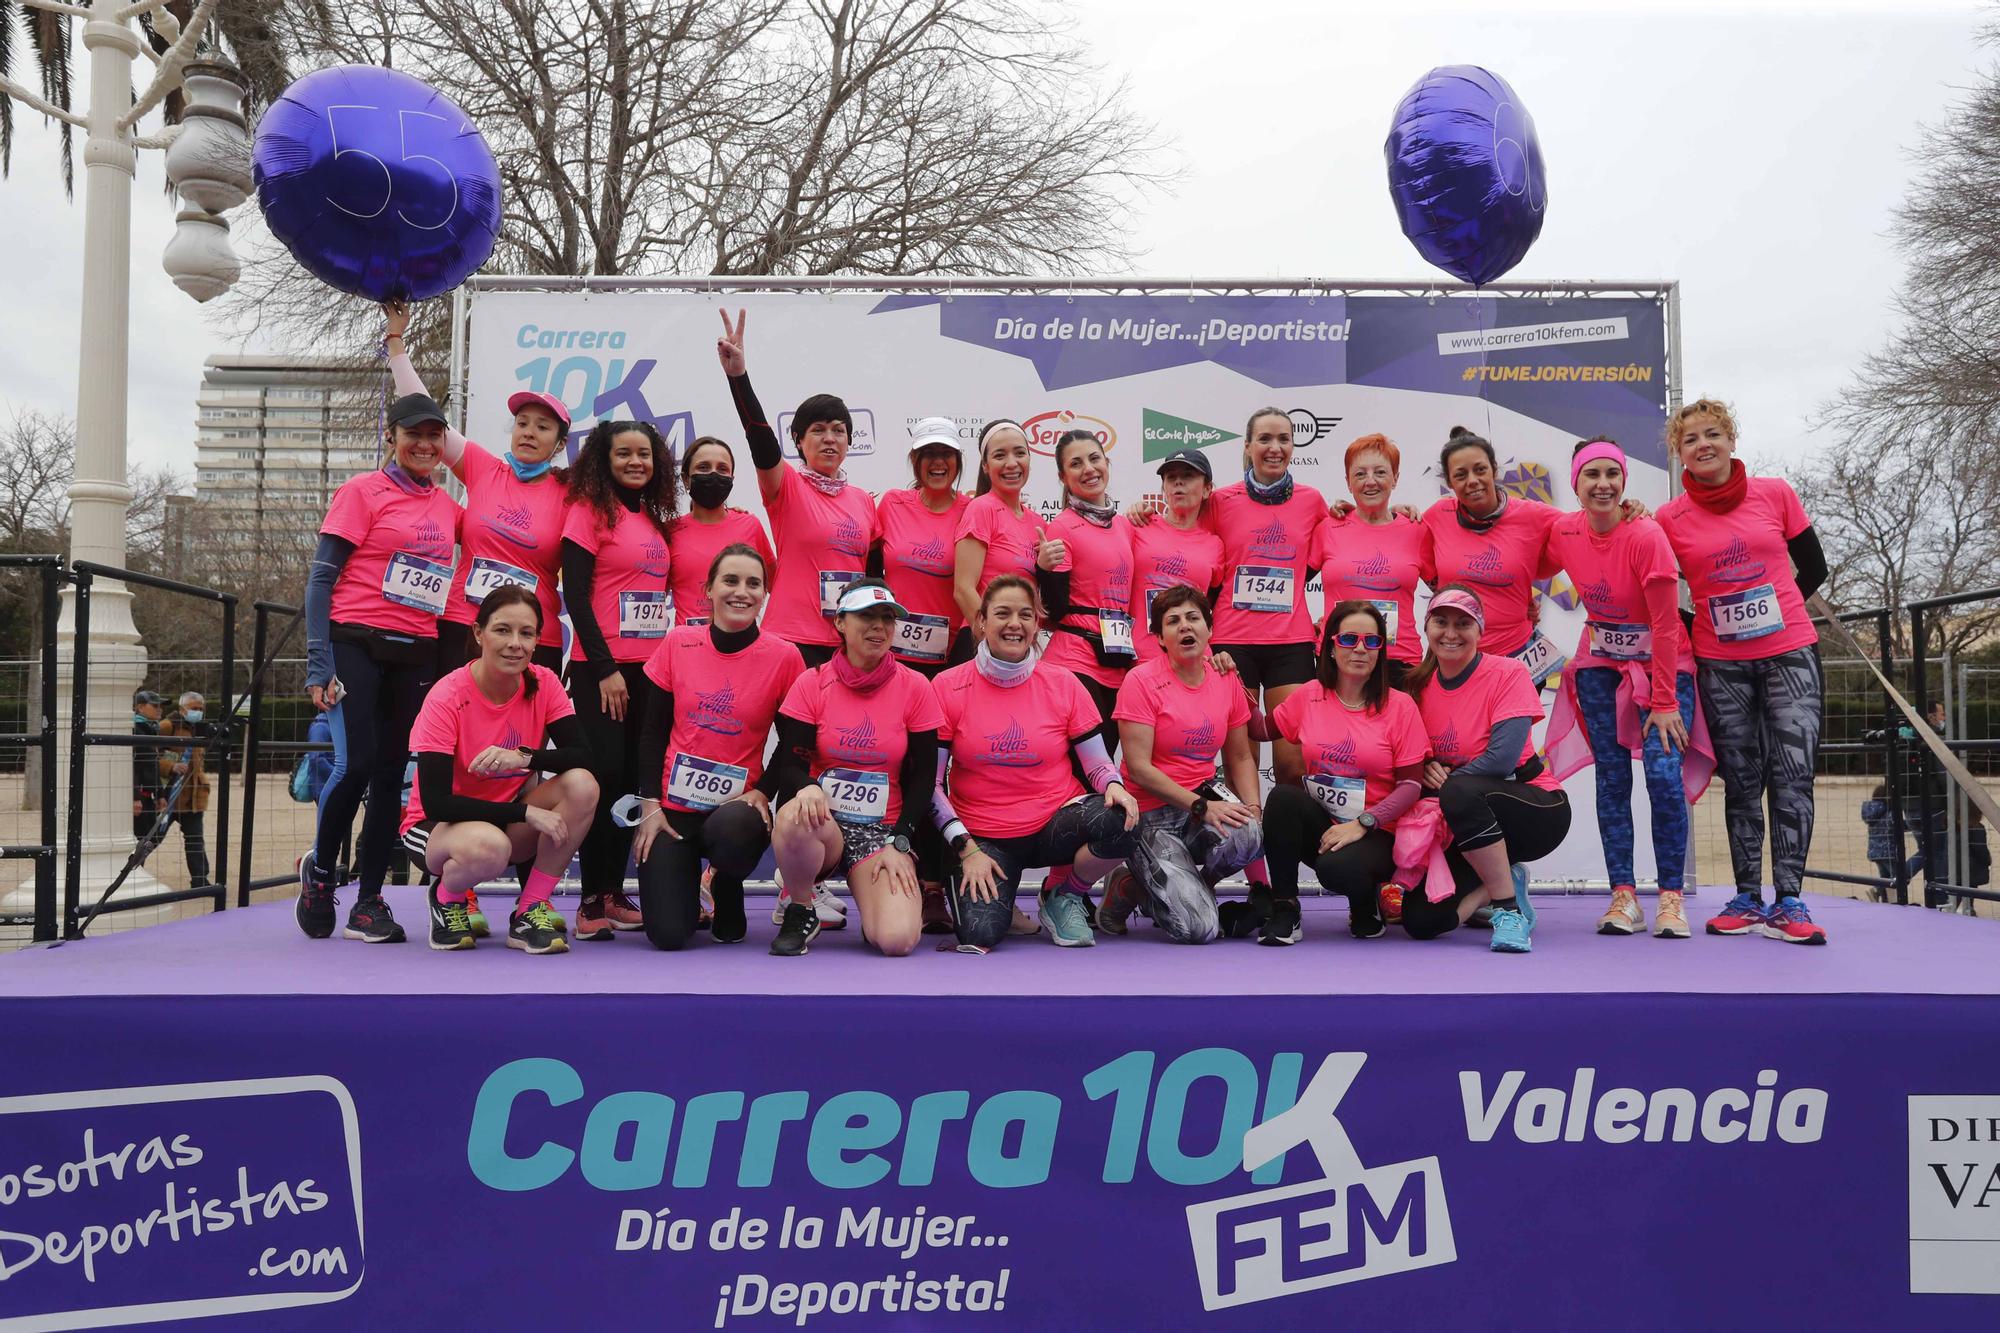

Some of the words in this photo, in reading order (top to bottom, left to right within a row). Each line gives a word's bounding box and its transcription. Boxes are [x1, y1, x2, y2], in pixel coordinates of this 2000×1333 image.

[326, 105, 457, 230] 55
[516, 324, 626, 349] Carrera
[994, 317, 1039, 340] Día
[1042, 317, 1073, 340] de
[1079, 317, 1102, 340] la
[1451, 322, 1616, 349] www.carrera10kfem.com
[1462, 363, 1652, 382] #TUMEJORVERSIÓN
[1156, 428, 1182, 440] Corte
[1183, 425, 1221, 444] Inglés
[400, 569, 442, 593] 1346
[1246, 577, 1285, 594] 1544
[633, 604, 663, 620] 1972
[1722, 599, 1769, 623] 1566
[901, 624, 933, 642] 851
[684, 770, 733, 796] 1869
[831, 782, 880, 803] 1296
[839, 803, 862, 813] PAULA
[1316, 786, 1348, 807] 926
[468, 1057, 1062, 1192] Carrera
[1083, 1048, 1367, 1186] 10K
[1459, 1067, 1829, 1144] Valencia
[0, 1167, 328, 1282] Deportistas
[616, 1207, 697, 1251] Día
[709, 1207, 769, 1251] de
[780, 1206, 824, 1249] la
[836, 1206, 1009, 1259] Mujer...
[1216, 1170, 1427, 1296] FEM
[249, 1247, 348, 1277] .com
[715, 1269, 1011, 1328] ¡Deportista!
